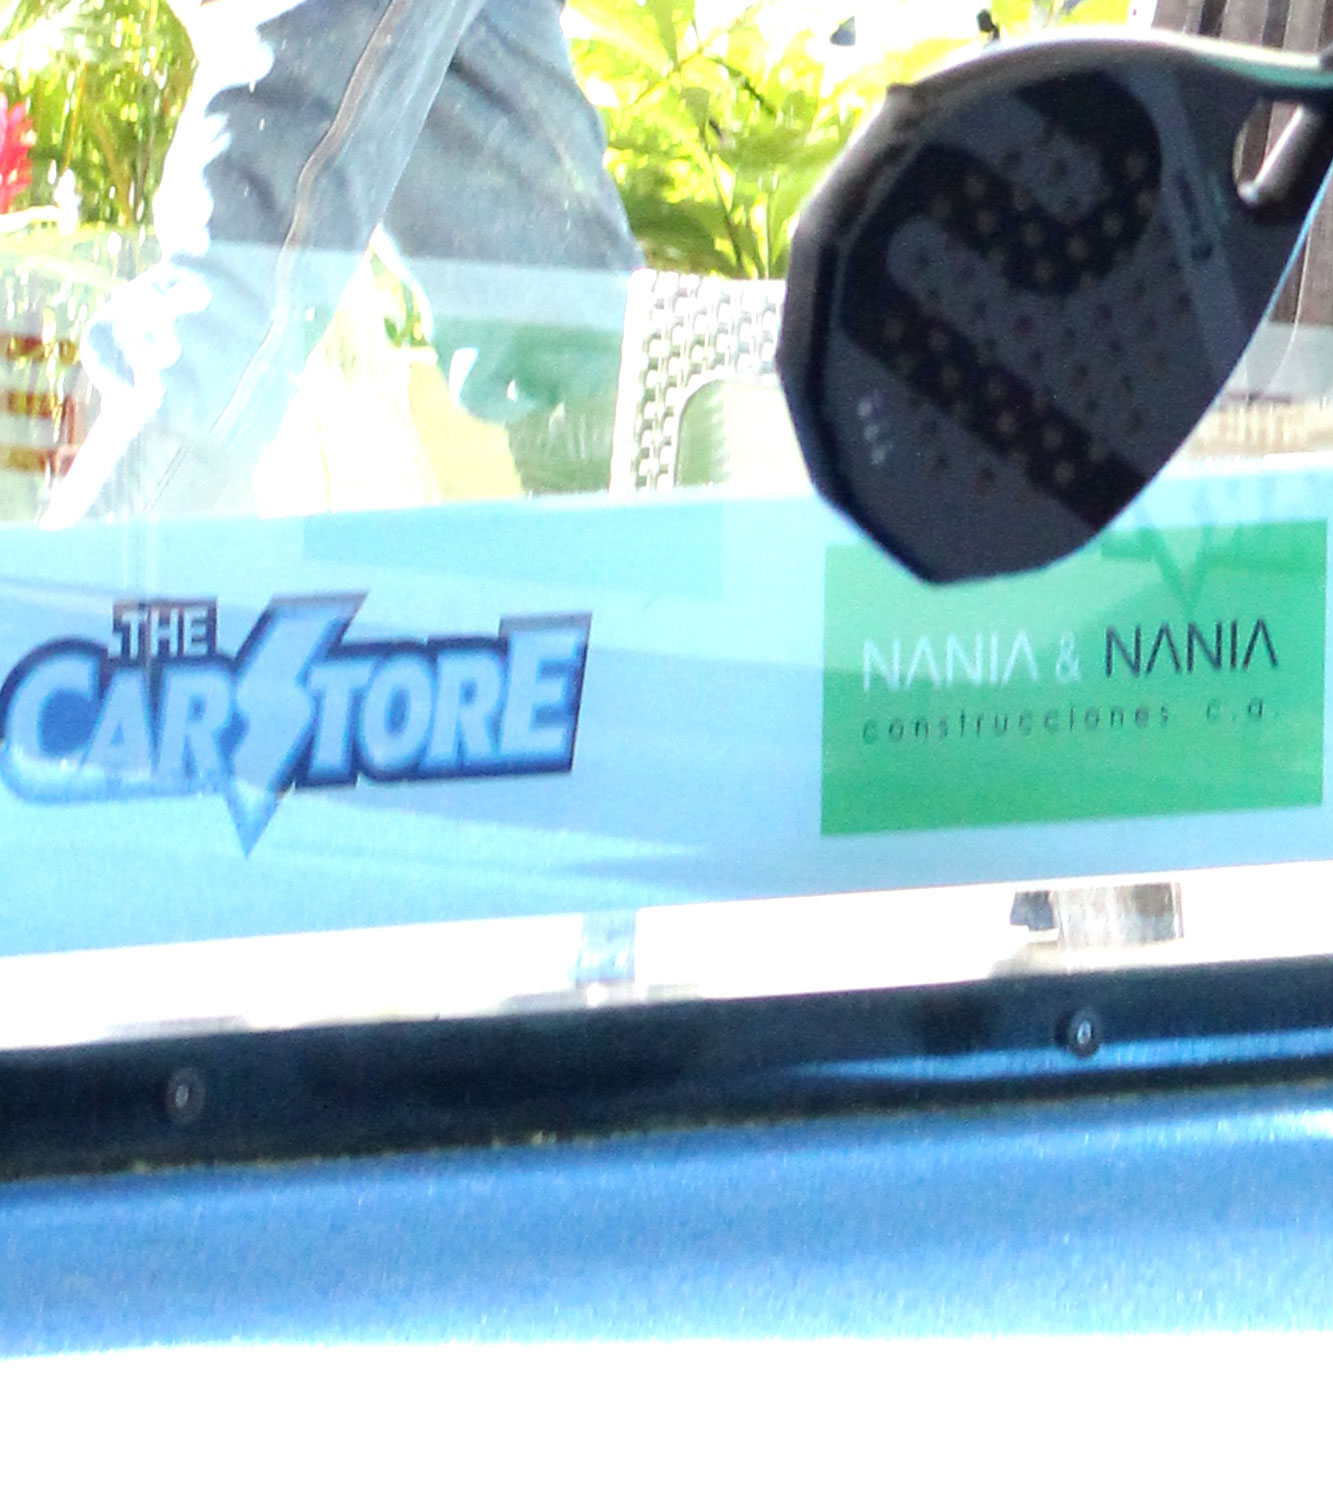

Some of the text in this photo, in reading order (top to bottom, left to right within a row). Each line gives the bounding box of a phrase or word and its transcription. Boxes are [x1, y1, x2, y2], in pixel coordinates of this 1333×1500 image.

[117, 605, 212, 658] THE
[863, 618, 1278, 692] NANIA & NANIA
[862, 704, 1171, 745] construcciones
